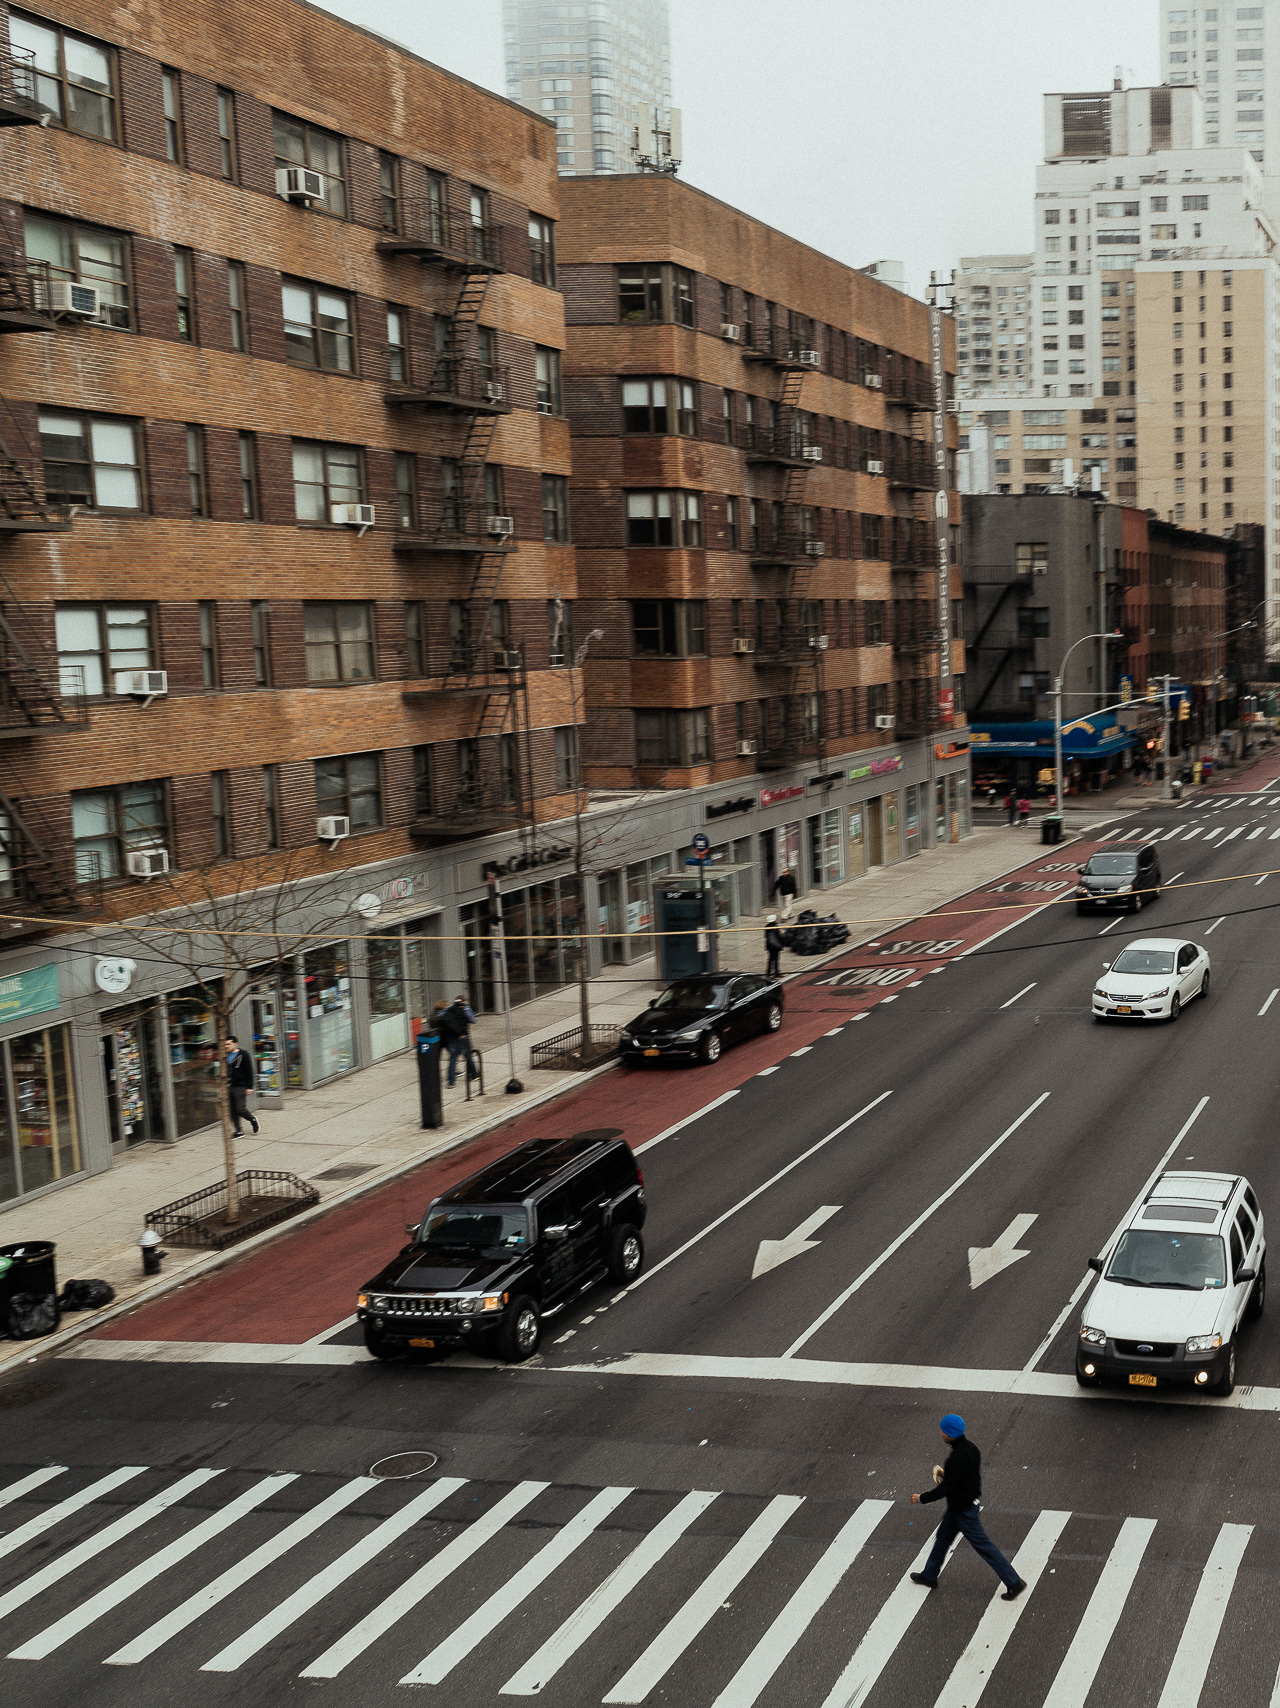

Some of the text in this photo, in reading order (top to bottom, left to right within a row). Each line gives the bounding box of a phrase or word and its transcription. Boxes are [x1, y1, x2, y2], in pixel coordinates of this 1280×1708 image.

[985, 881, 1072, 893] ONLY
[880, 940, 968, 955] BUS
[814, 968, 920, 986] ONLY
